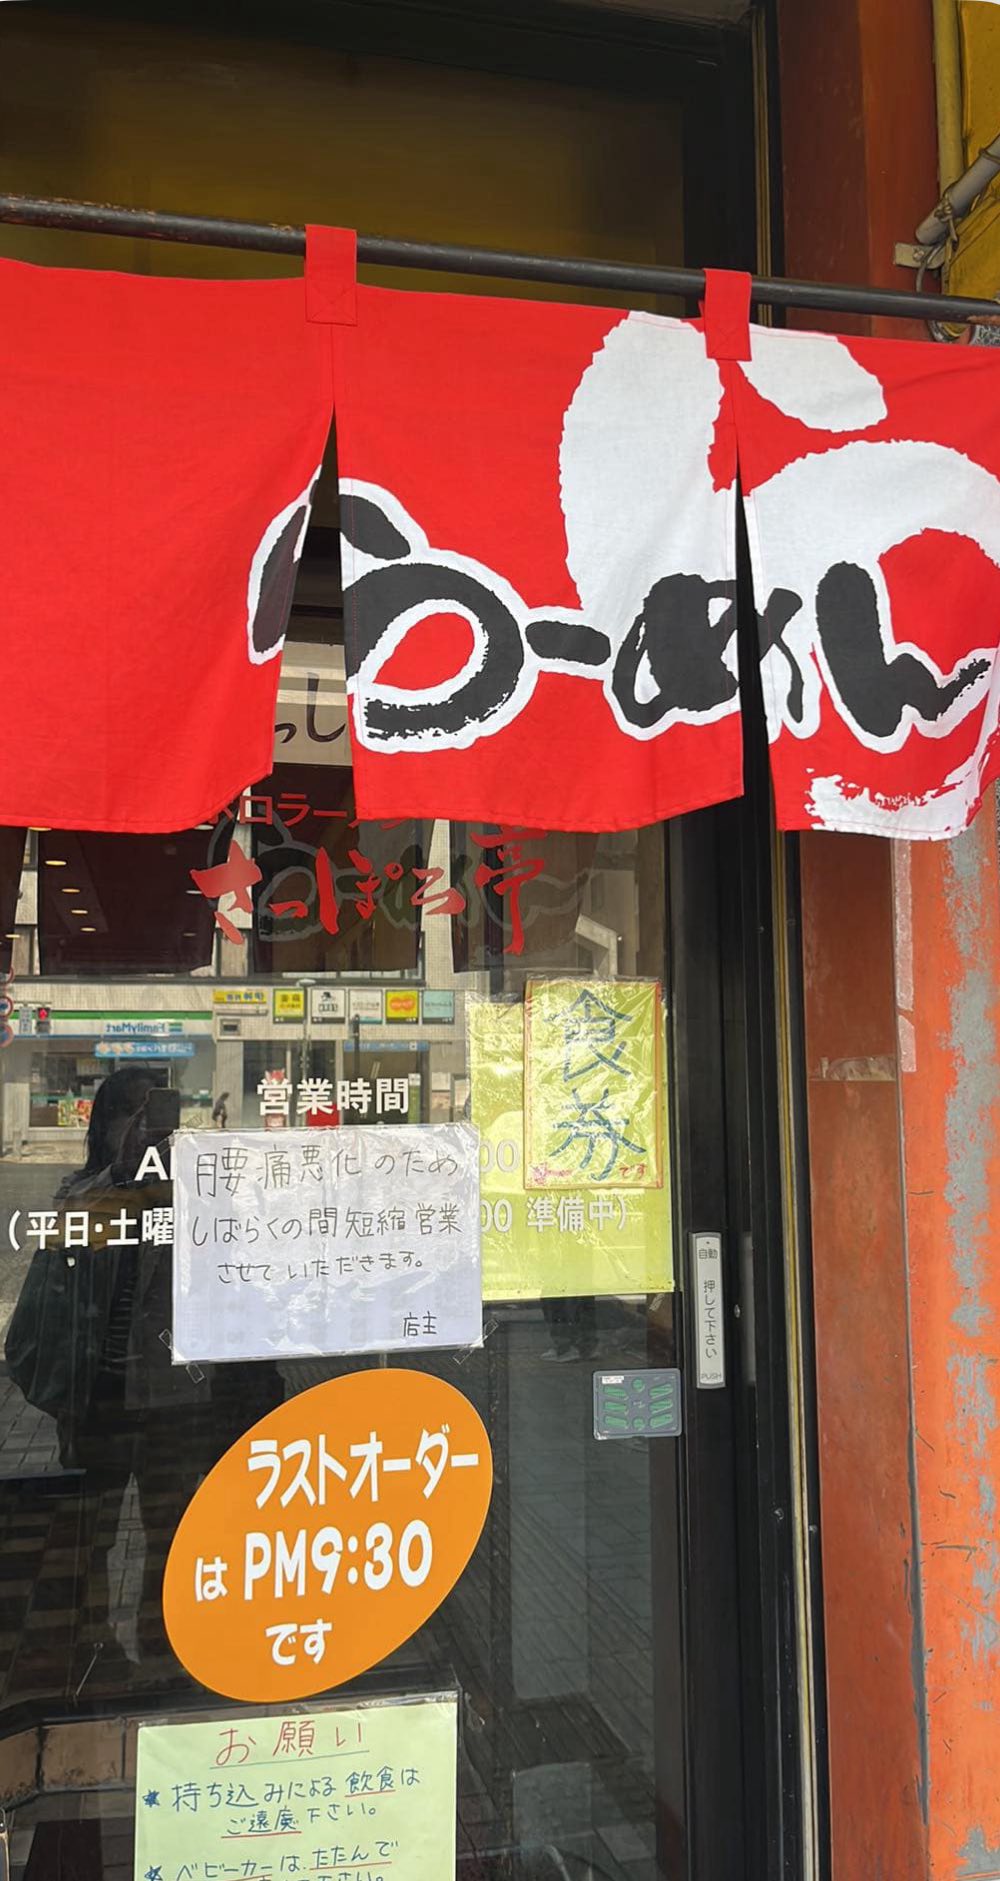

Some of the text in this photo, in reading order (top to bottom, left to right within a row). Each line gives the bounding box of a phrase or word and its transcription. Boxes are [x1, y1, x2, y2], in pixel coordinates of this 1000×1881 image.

[252, 492, 990, 741] らーめん
[257, 1078, 409, 1116] 営業時間
[548, 988, 648, 1181] 食券
[134, 1146, 173, 1181] A
[196, 1143, 458, 1198] 腰痛悪化のため
[191, 1202, 465, 1247] しばらくの間短縮営業
[217, 1250, 424, 1285] させていただきます。
[698, 1248, 718, 1260] 自動
[402, 1311, 437, 1338] 店主
[704, 1279, 718, 1359] 押して下さい
[701, 1372, 722, 1381] PUSH
[247, 1423, 479, 1509] ラストオーダー
[244, 1520, 432, 1600] PM9:30
[265, 1619, 333, 1665] です
[215, 1720, 362, 1767] お願い
